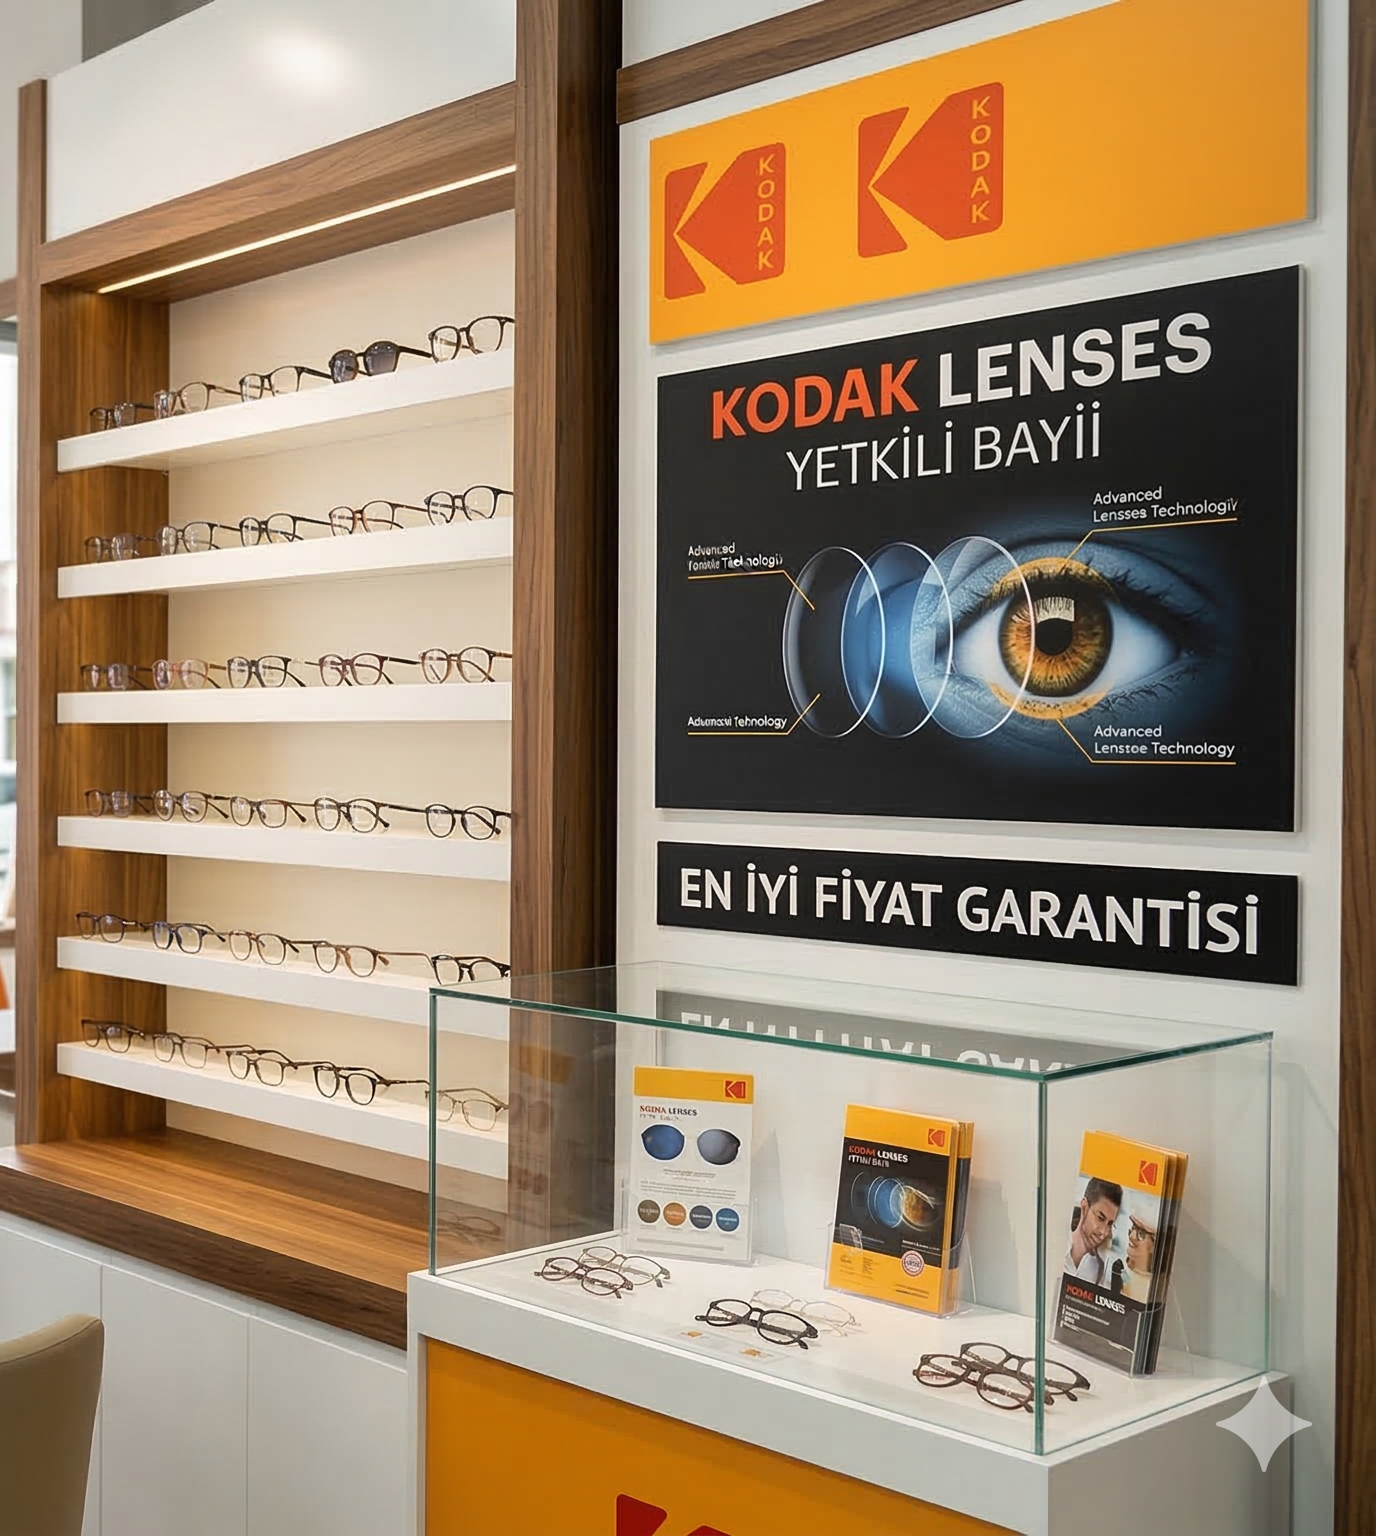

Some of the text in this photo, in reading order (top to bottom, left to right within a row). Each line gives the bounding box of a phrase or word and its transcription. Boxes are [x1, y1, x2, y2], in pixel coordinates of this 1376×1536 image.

[970, 95, 992, 224] KODAK
[757, 153, 776, 272] KODAK
[712, 311, 1212, 440] KODAK LENSES
[786, 400, 1101, 491] YETKİLİ BAYİİ
[1093, 486, 1163, 505] Advanced
[1094, 725, 1162, 737] Advanced
[1151, 742, 1235, 758] Technology
[681, 862, 1259, 955] EN İYİ FİYAT GARANTİSİ
